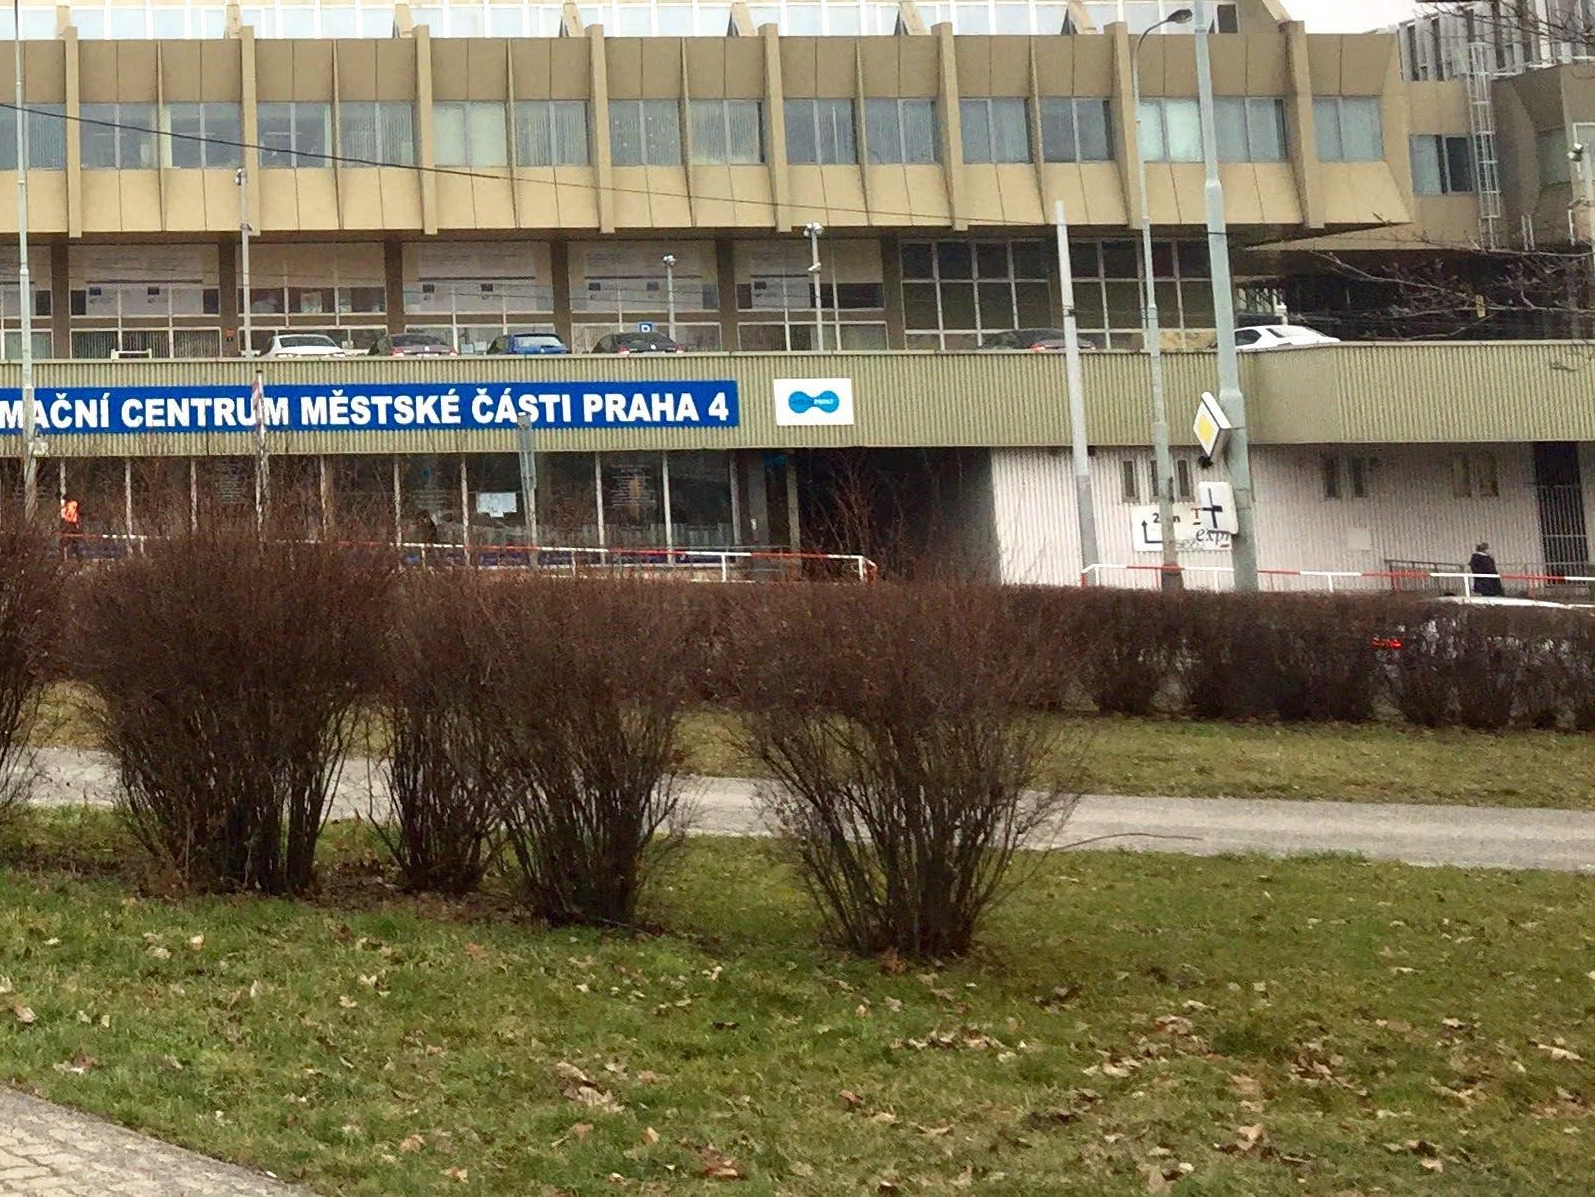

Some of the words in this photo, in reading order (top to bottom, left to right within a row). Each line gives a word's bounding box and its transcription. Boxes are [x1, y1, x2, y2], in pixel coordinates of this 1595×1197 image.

[121, 397, 289, 429] CENTRUM
[300, 389, 462, 425] MĚSTSKÉ
[471, 388, 572, 423] ČÁSTI
[583, 393, 700, 423] PRAHA
[708, 393, 730, 421] 4
